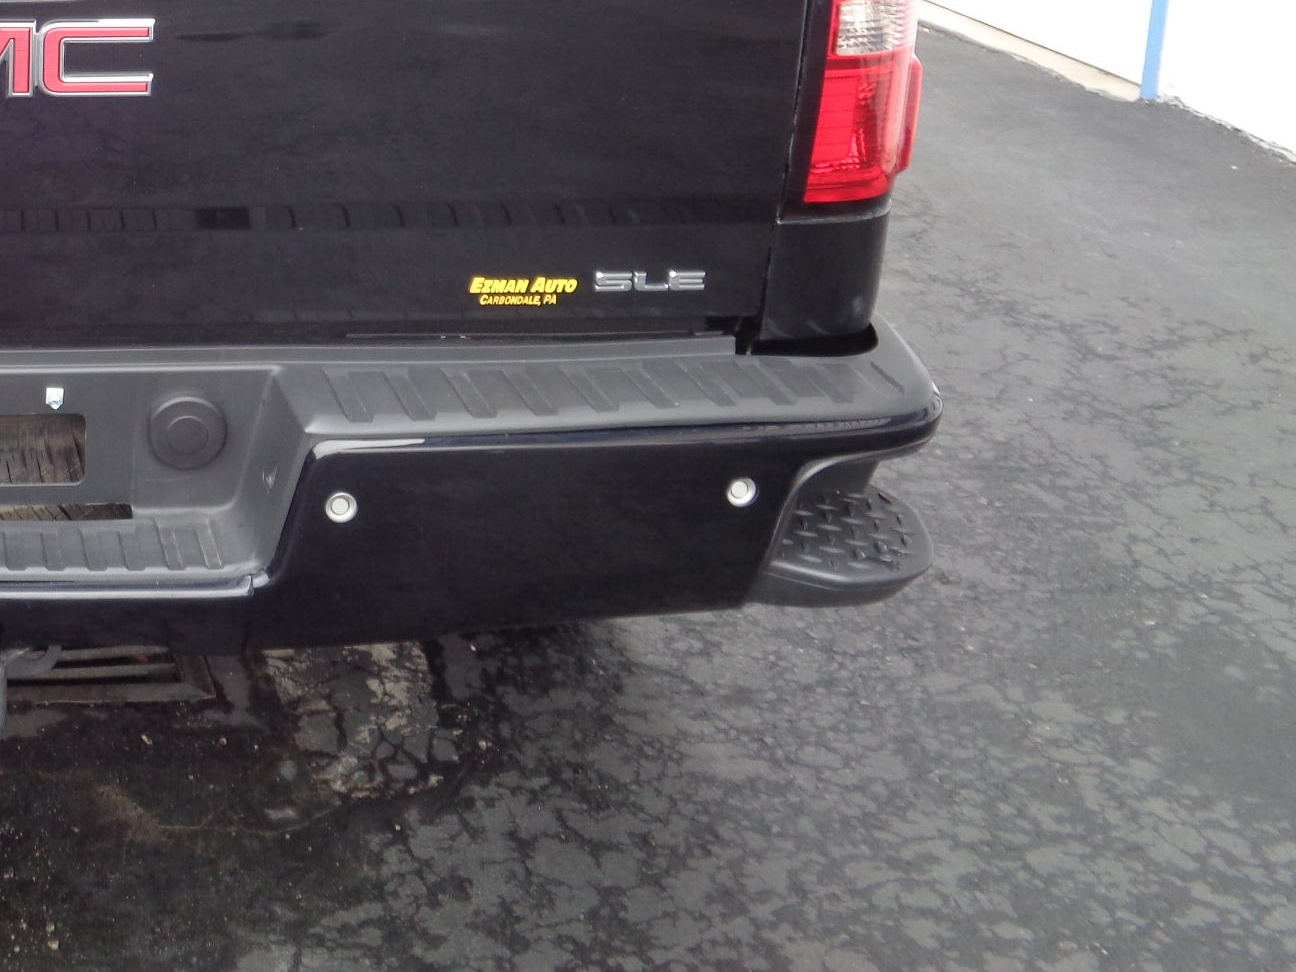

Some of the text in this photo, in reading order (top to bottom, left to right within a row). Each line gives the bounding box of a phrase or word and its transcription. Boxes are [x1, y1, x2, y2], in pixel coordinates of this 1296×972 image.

[469, 276, 578, 294] EZMAN AUTO
[594, 271, 706, 292] SLE
[543, 294, 558, 306] PA
